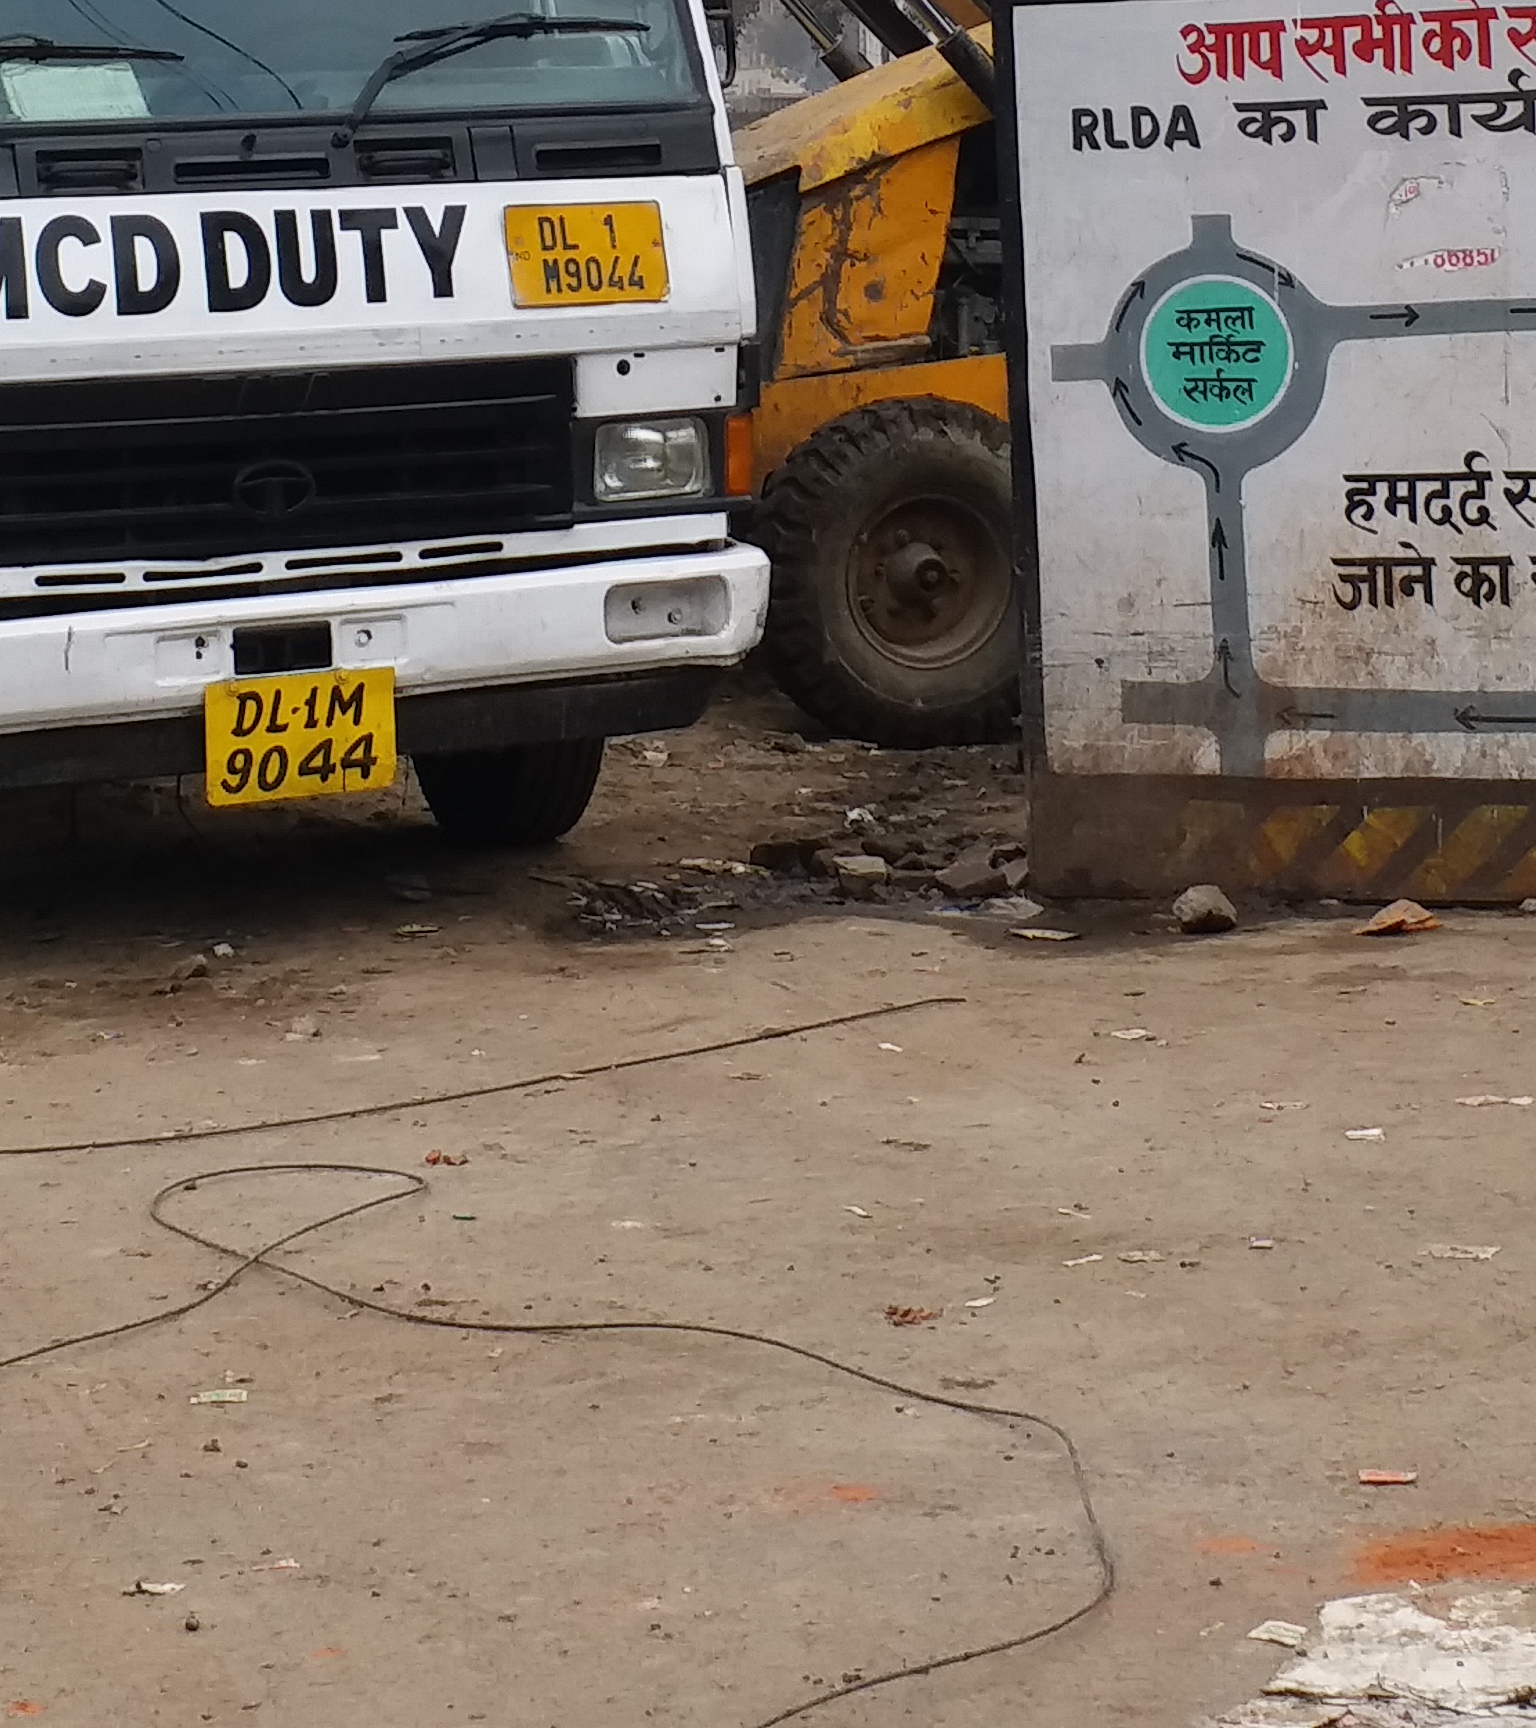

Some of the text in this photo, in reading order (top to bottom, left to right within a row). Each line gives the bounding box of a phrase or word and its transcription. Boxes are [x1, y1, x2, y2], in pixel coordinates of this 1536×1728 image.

[1176, 19, 1287, 84] आप
[1072, 106, 1200, 150] RLDA
[1233, 99, 1328, 145] का
[198, 203, 468, 313] DUTY
[537, 213, 618, 251] DL 1
[542, 254, 645, 294] M9044
[1175, 306, 1255, 333] कमला
[1183, 369, 1258, 404] सर्कल
[1343, 450, 1497, 535] हमदर्द
[1330, 541, 1435, 612] जाने
[1449, 555, 1513, 610] का
[220, 732, 378, 795] 9044
